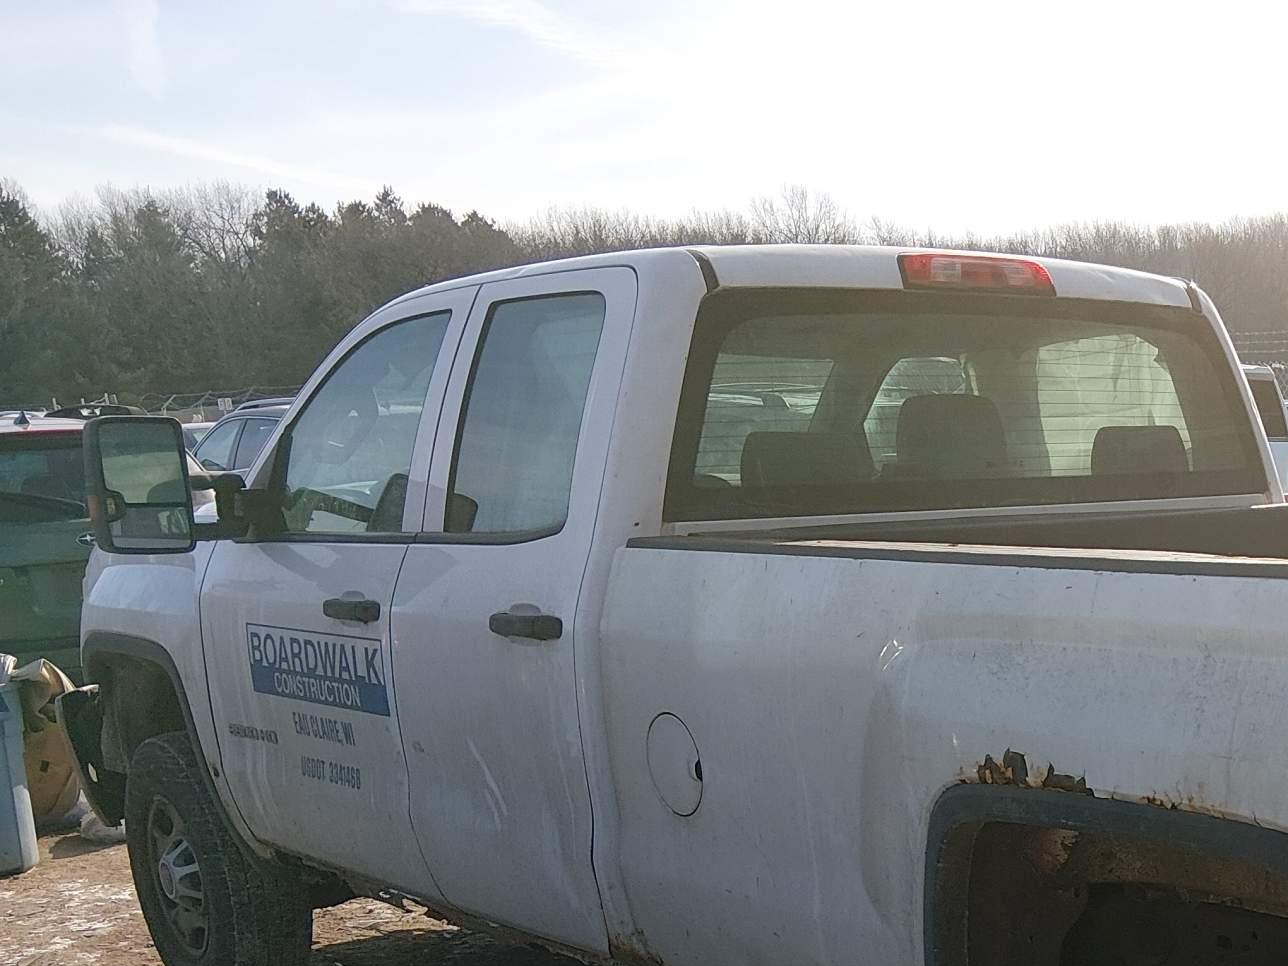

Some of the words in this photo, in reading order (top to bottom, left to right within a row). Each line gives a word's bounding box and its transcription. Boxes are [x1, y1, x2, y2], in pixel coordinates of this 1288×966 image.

[249, 631, 385, 686] BOARDWALK
[273, 672, 362, 707] CONSTRUCTION
[292, 711, 311, 737] EAU
